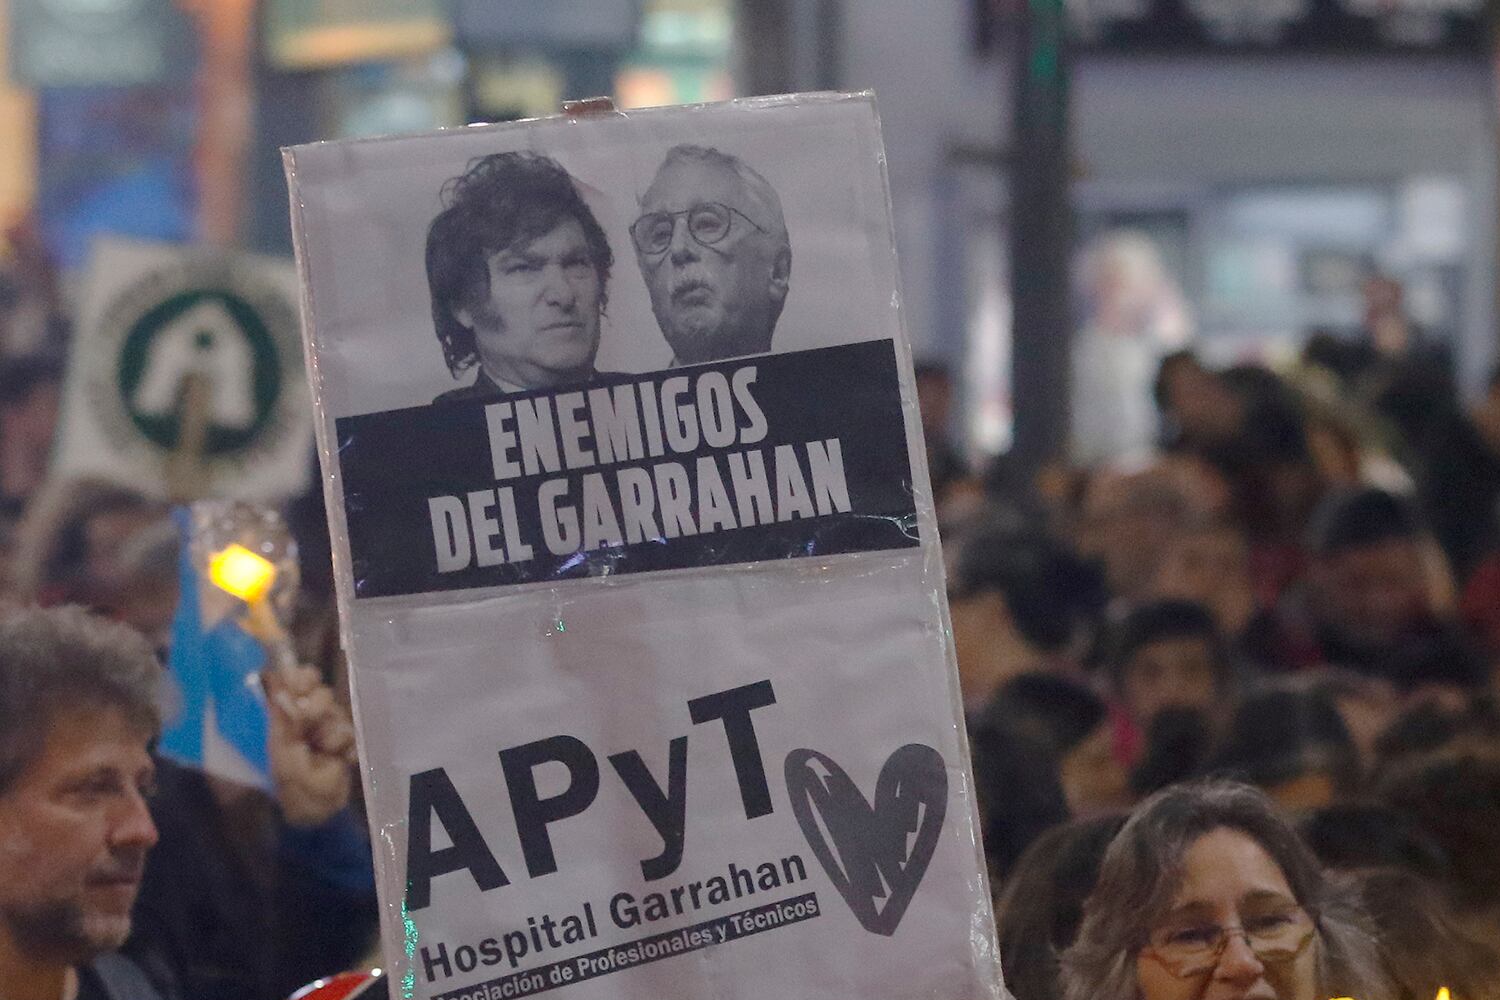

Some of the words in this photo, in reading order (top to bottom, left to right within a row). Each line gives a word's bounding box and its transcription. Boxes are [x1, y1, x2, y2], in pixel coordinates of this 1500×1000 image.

[485, 366, 768, 480] ENEMIGOS
[428, 486, 533, 574] DEL
[537, 438, 852, 557] GARRAHAN
[404, 679, 777, 912] APyT
[421, 902, 598, 983] Hospital
[609, 854, 808, 930] Garrahan
[550, 962, 574, 985] de
[577, 927, 713, 977] Profesionales
[715, 923, 728, 943] y
[730, 899, 818, 934] Técnicos
